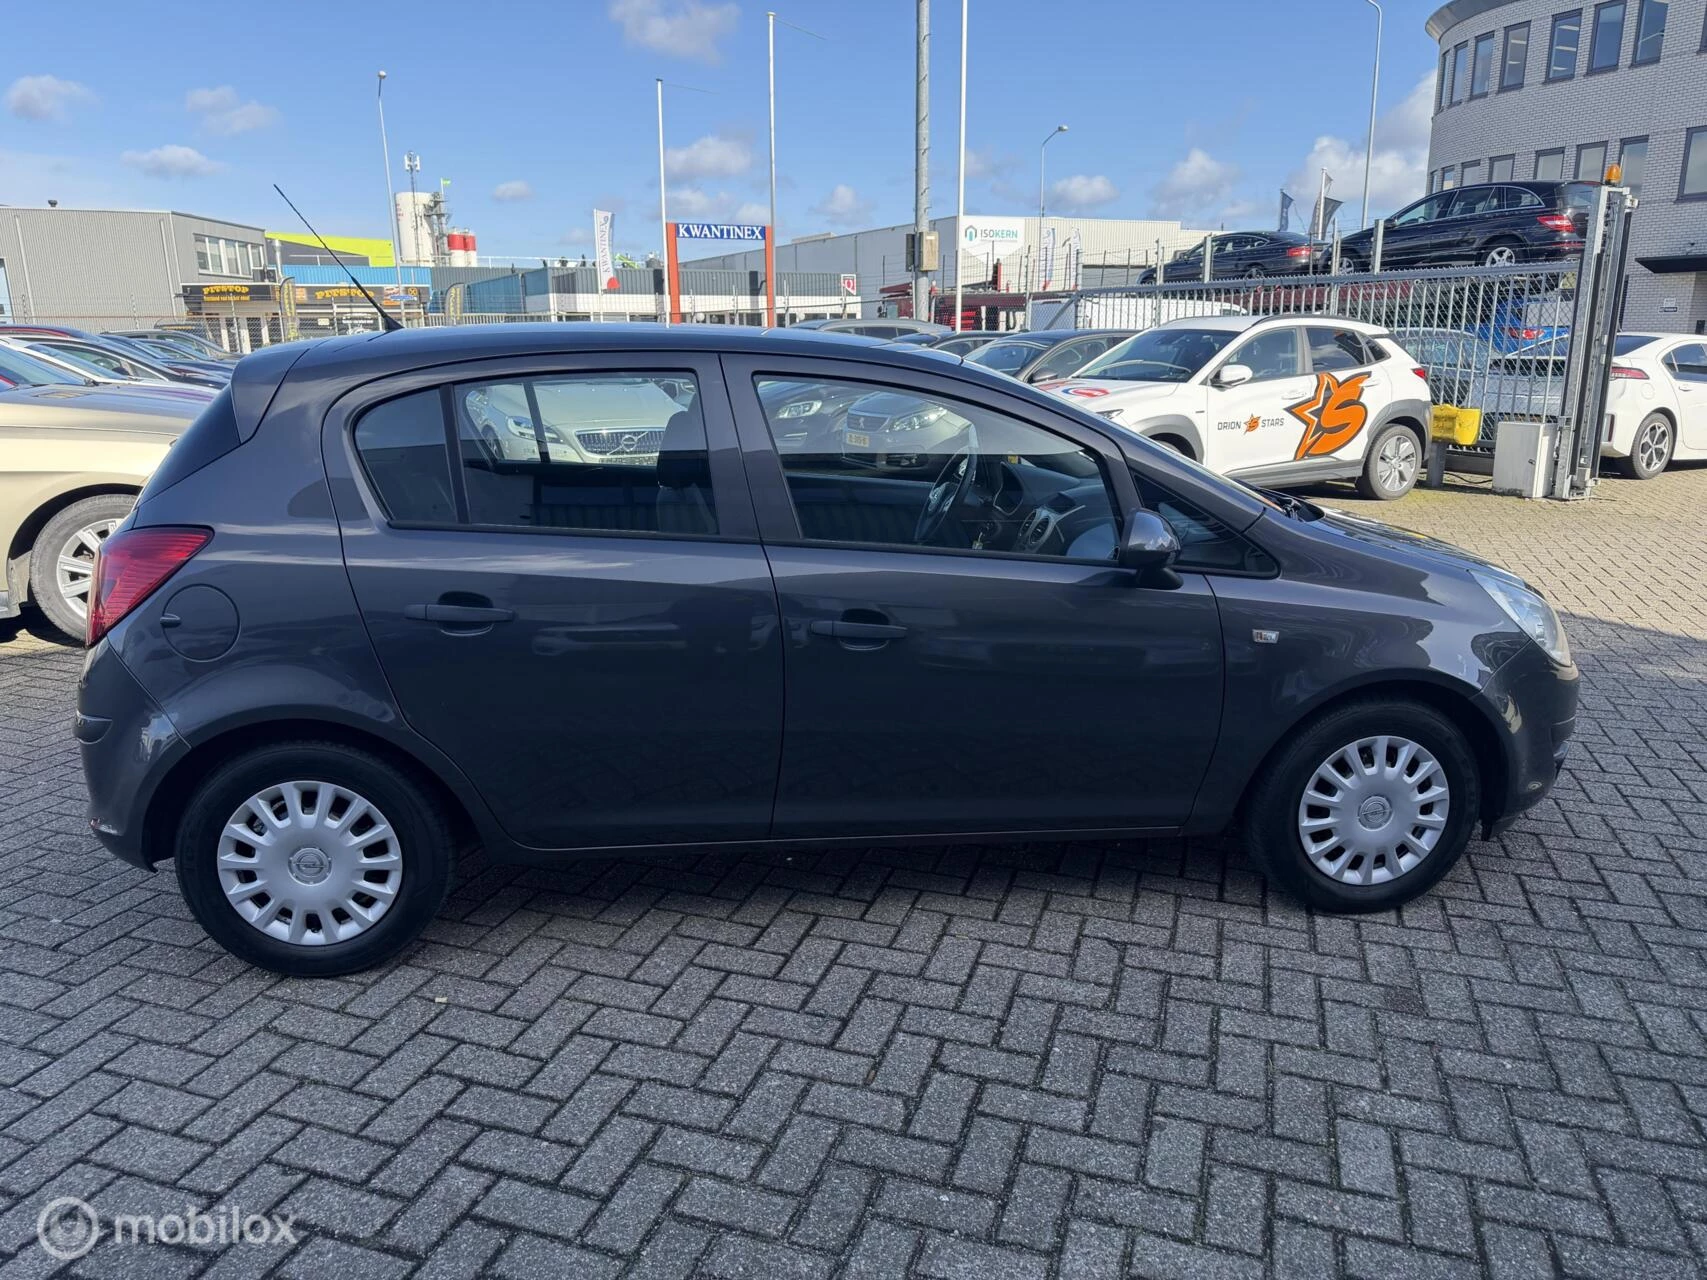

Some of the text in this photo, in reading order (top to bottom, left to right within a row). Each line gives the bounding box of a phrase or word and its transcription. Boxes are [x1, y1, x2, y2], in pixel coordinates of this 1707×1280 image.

[678, 224, 764, 240] KWANTINEX
[980, 229, 1018, 239] ISOKERN
[600, 222, 610, 273] KWANTINEX
[202, 284, 250, 295] PITSTOP
[1217, 421, 1242, 431] ORION
[1261, 418, 1285, 428] STARS
